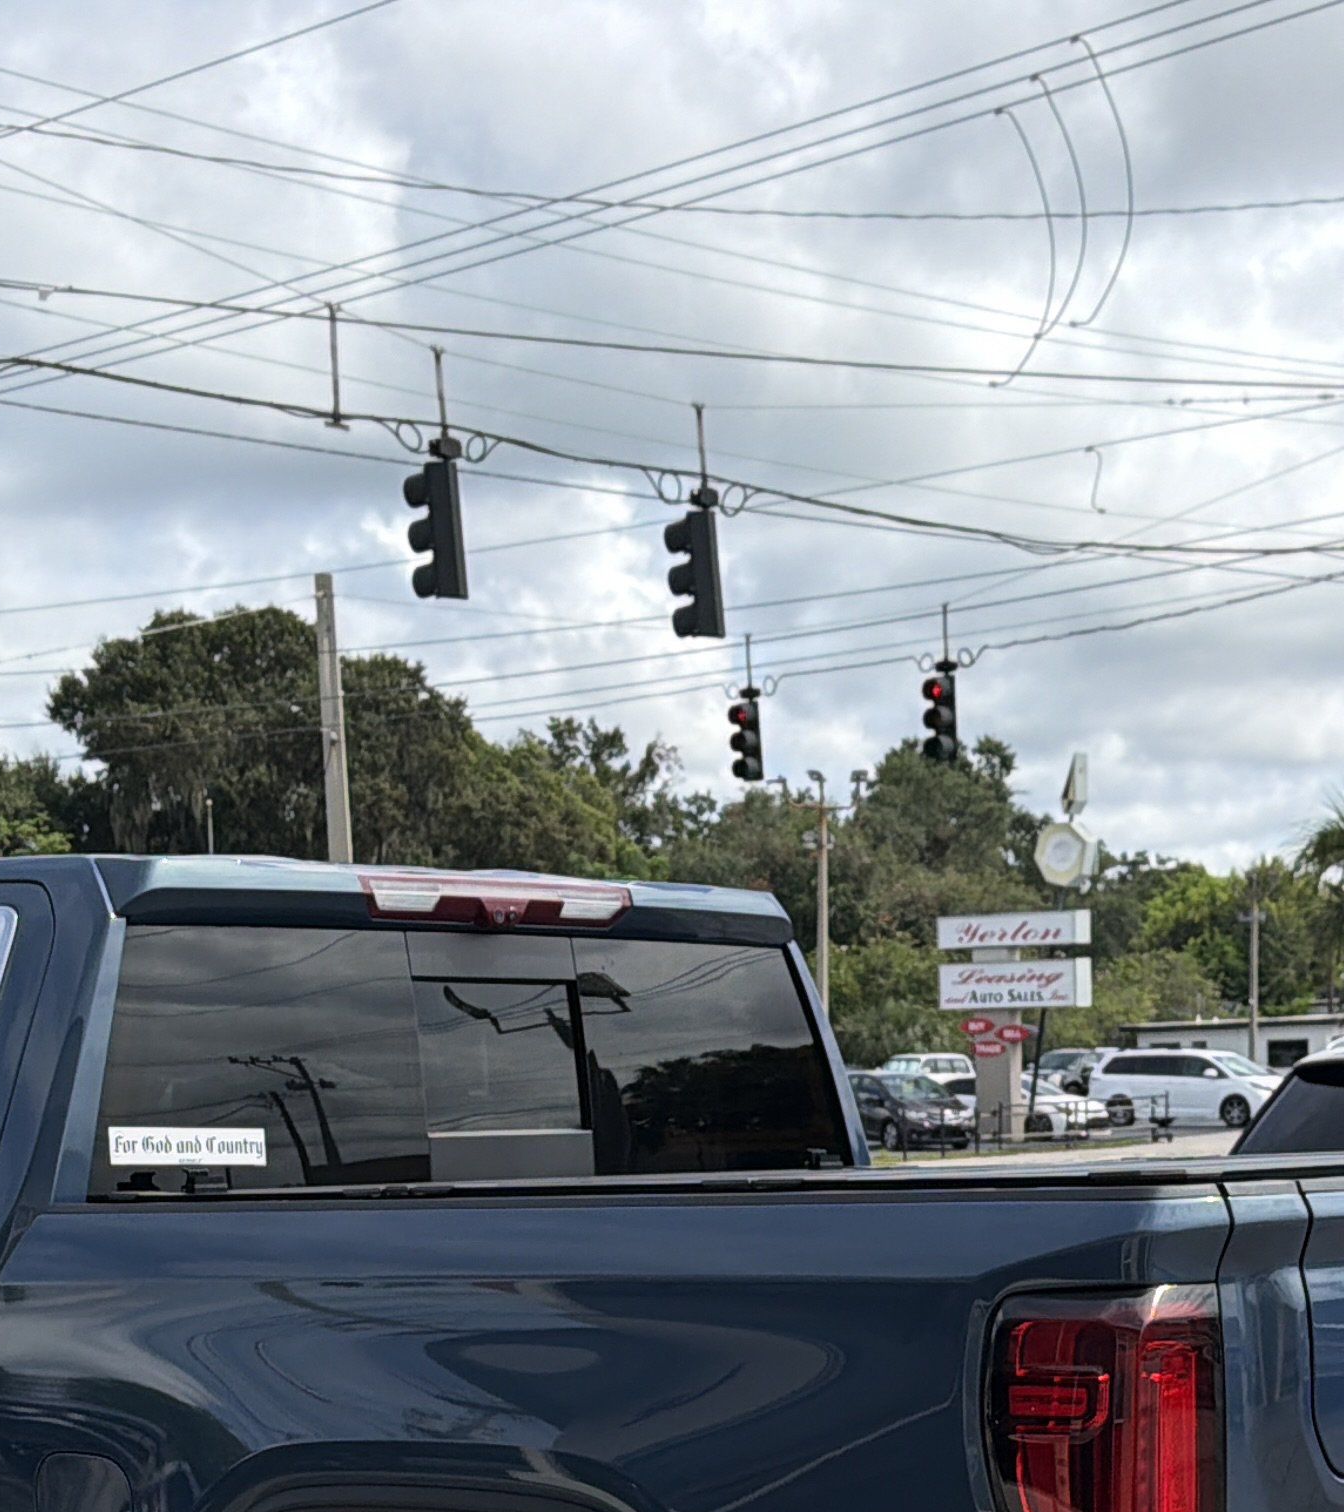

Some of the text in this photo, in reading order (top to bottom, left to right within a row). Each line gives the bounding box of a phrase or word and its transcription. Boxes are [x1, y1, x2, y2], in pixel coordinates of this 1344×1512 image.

[114, 1135, 264, 1159] For God and Country
